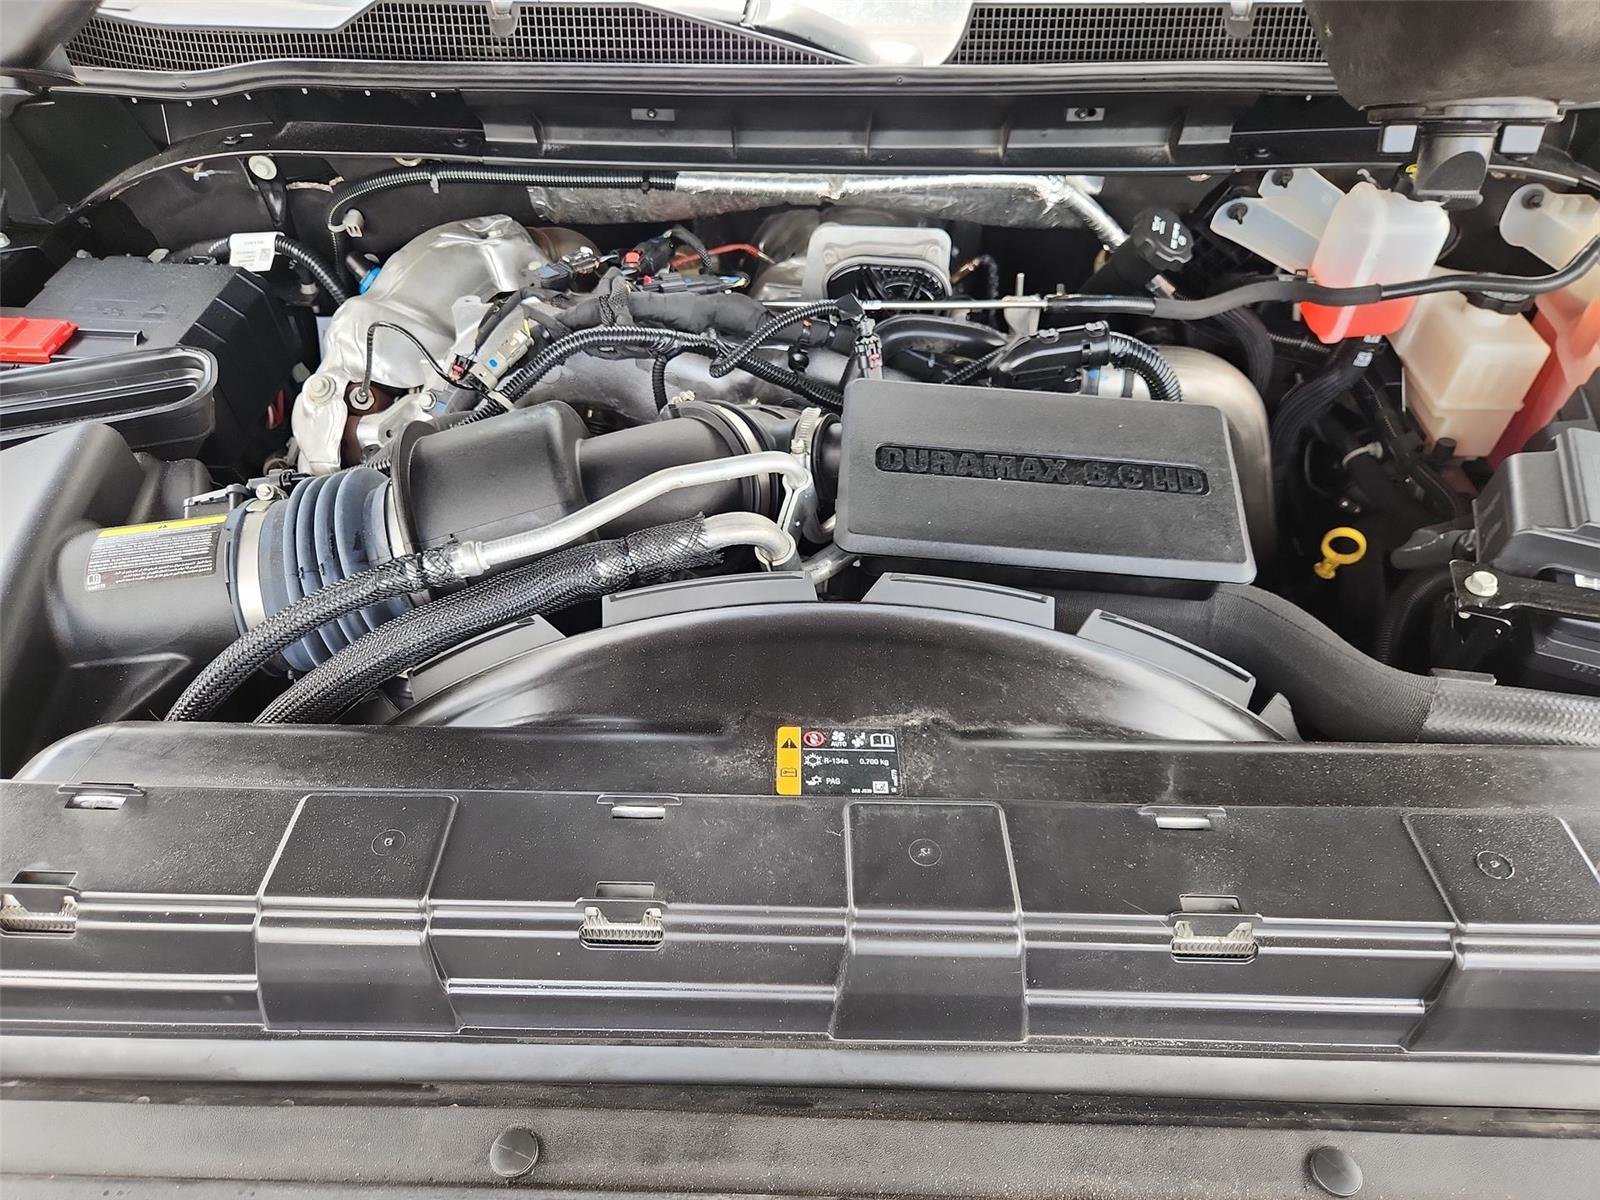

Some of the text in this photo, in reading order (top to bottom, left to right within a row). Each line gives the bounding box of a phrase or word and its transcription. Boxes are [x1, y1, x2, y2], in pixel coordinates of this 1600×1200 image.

[879, 446, 1205, 494] DURAMAX 6.6 HD
[824, 757, 849, 765] R-134a
[880, 758, 889, 766] kg
[826, 777, 841, 785] PAG
